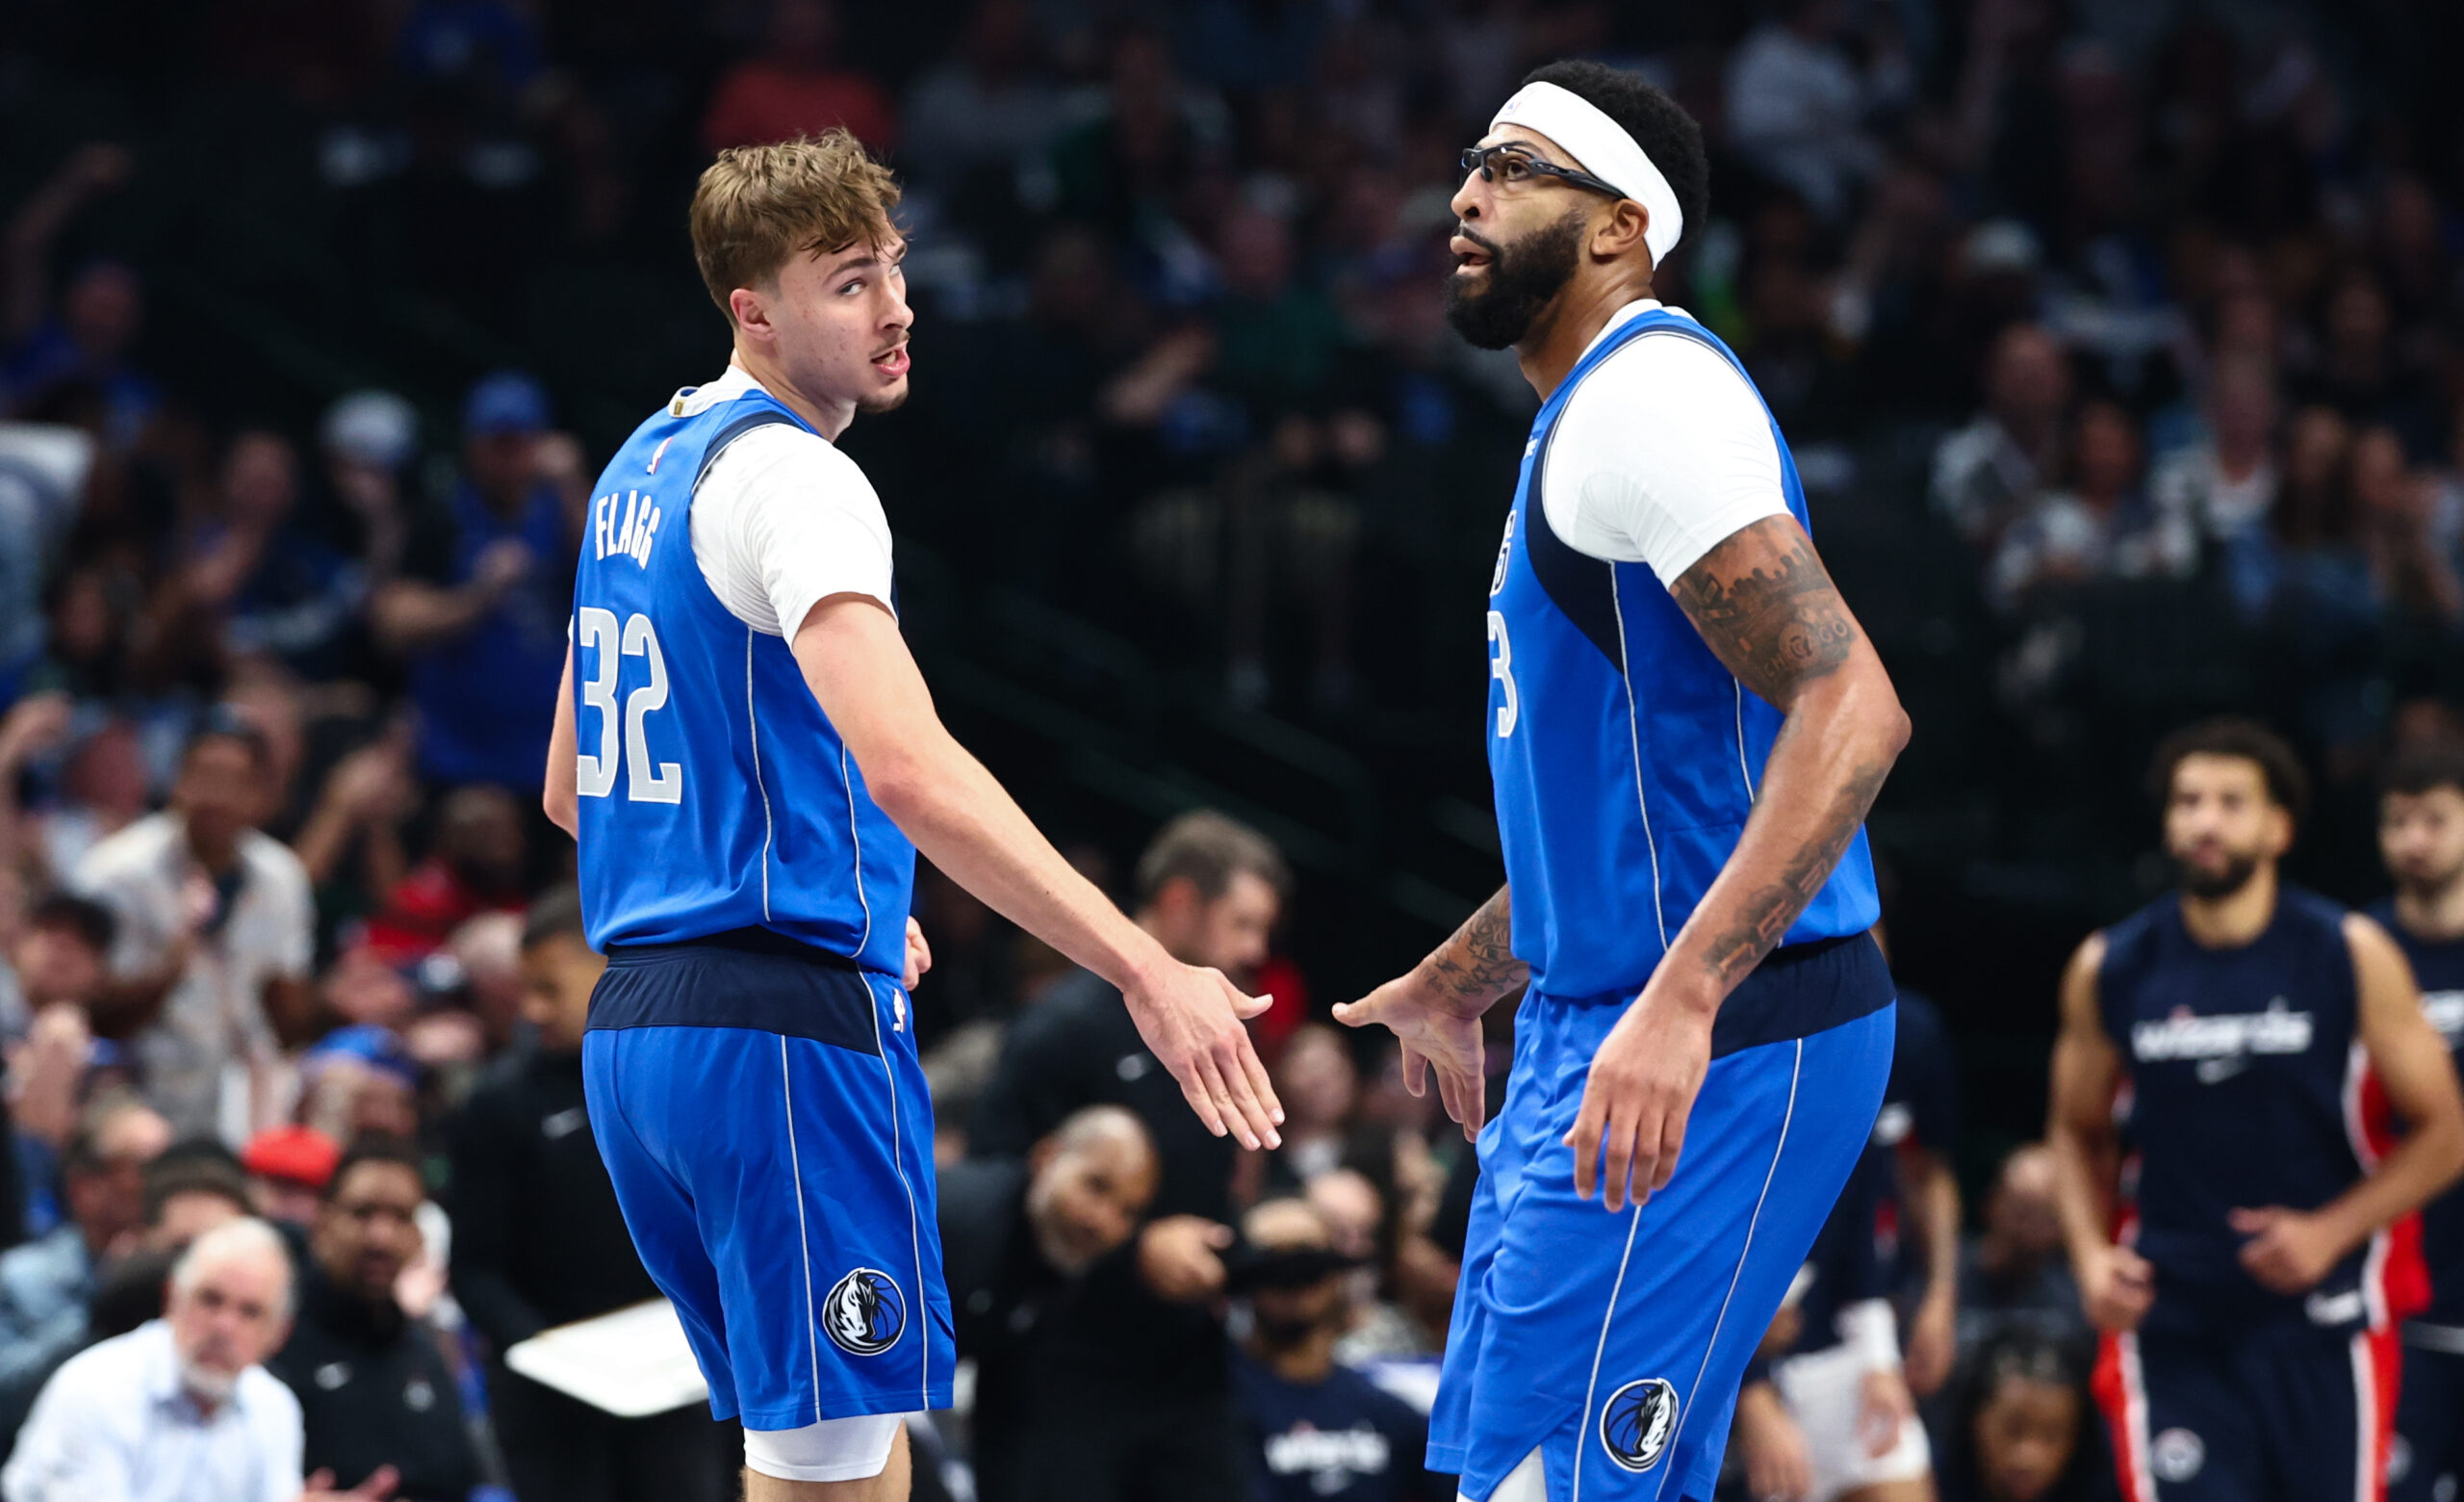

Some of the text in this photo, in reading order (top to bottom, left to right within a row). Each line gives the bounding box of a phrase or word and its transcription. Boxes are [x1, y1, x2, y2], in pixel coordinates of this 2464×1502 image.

[595, 489, 661, 570] FLAGG
[578, 606, 682, 805] 32
[1487, 609, 1519, 738] 3
